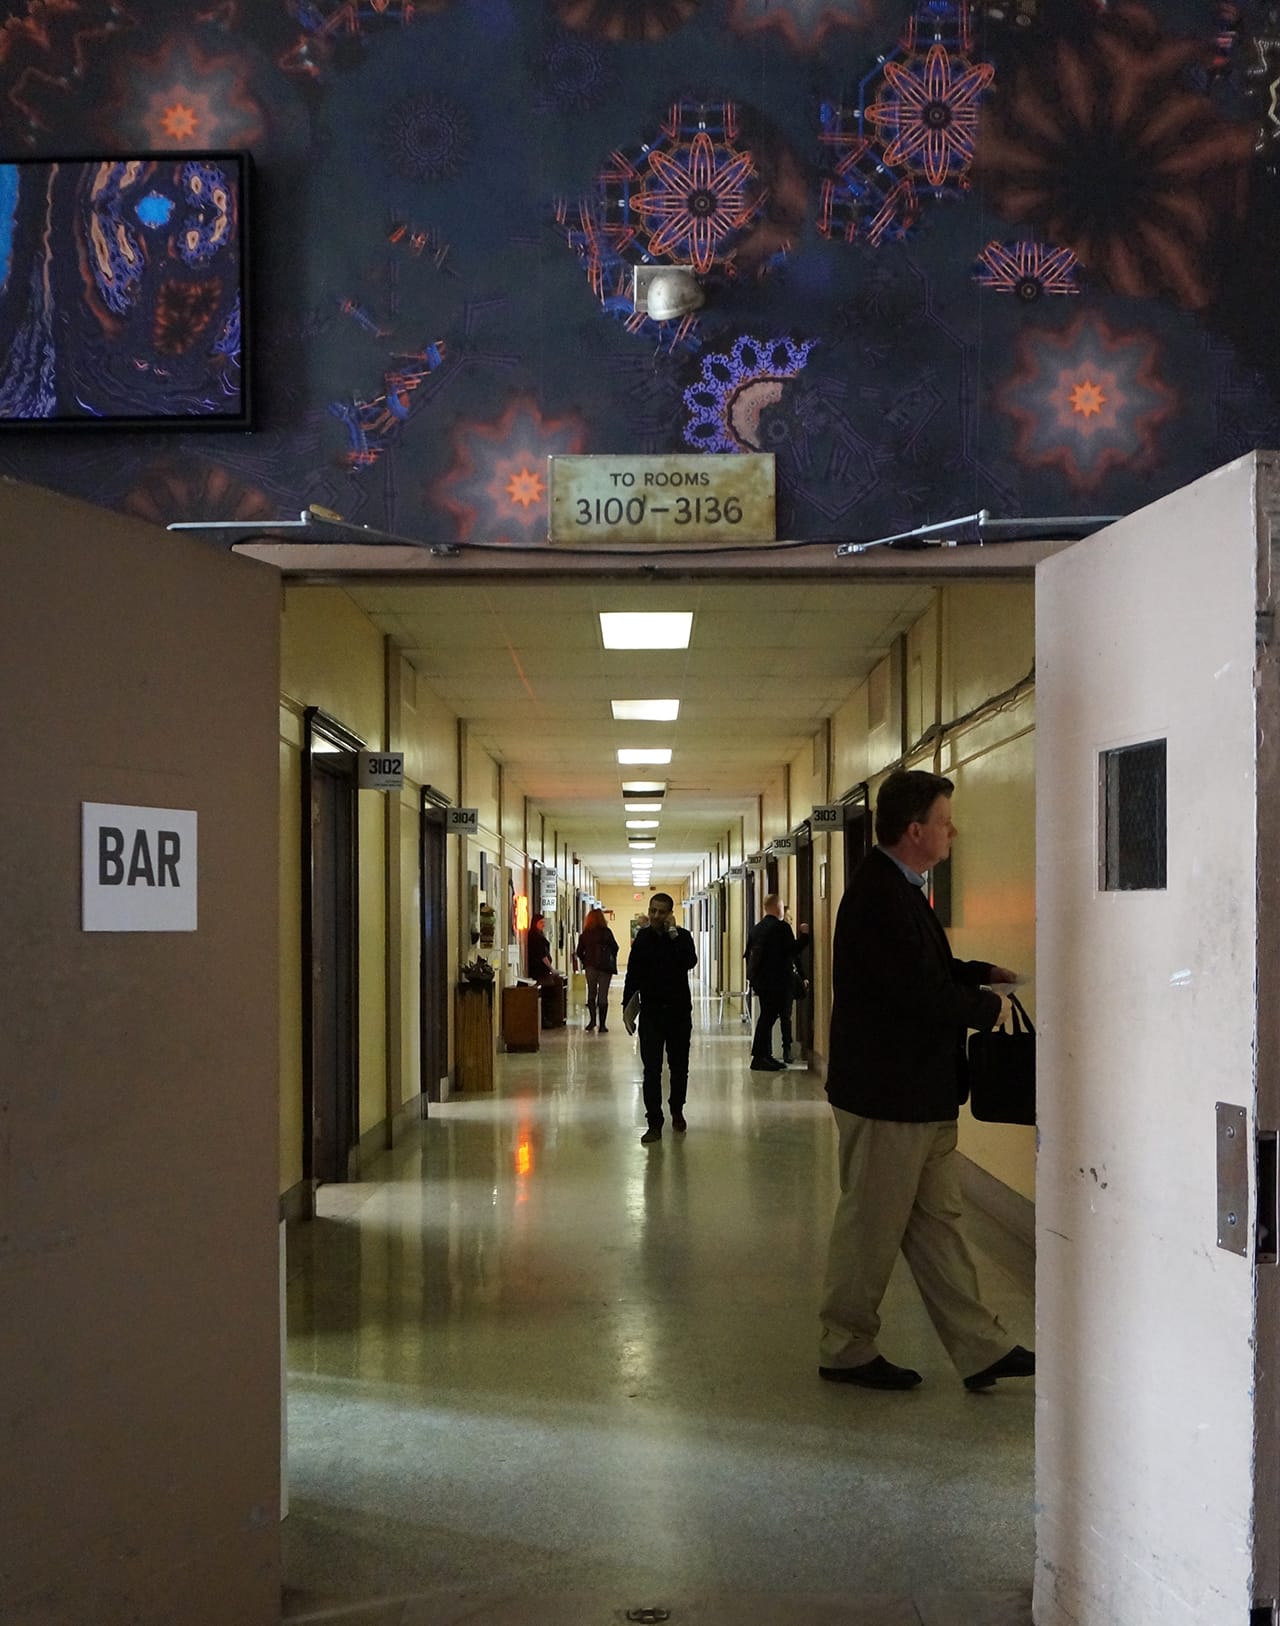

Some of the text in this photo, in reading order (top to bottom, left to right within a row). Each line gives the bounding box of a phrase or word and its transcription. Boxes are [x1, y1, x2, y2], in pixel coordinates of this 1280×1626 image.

[610, 472, 709, 487] TO ROOMS
[368, 759, 401, 775] 3102
[452, 812, 475, 824] 3104
[814, 810, 836, 821] 3103
[773, 839, 791, 848] 3105
[98, 826, 180, 886] BAR
